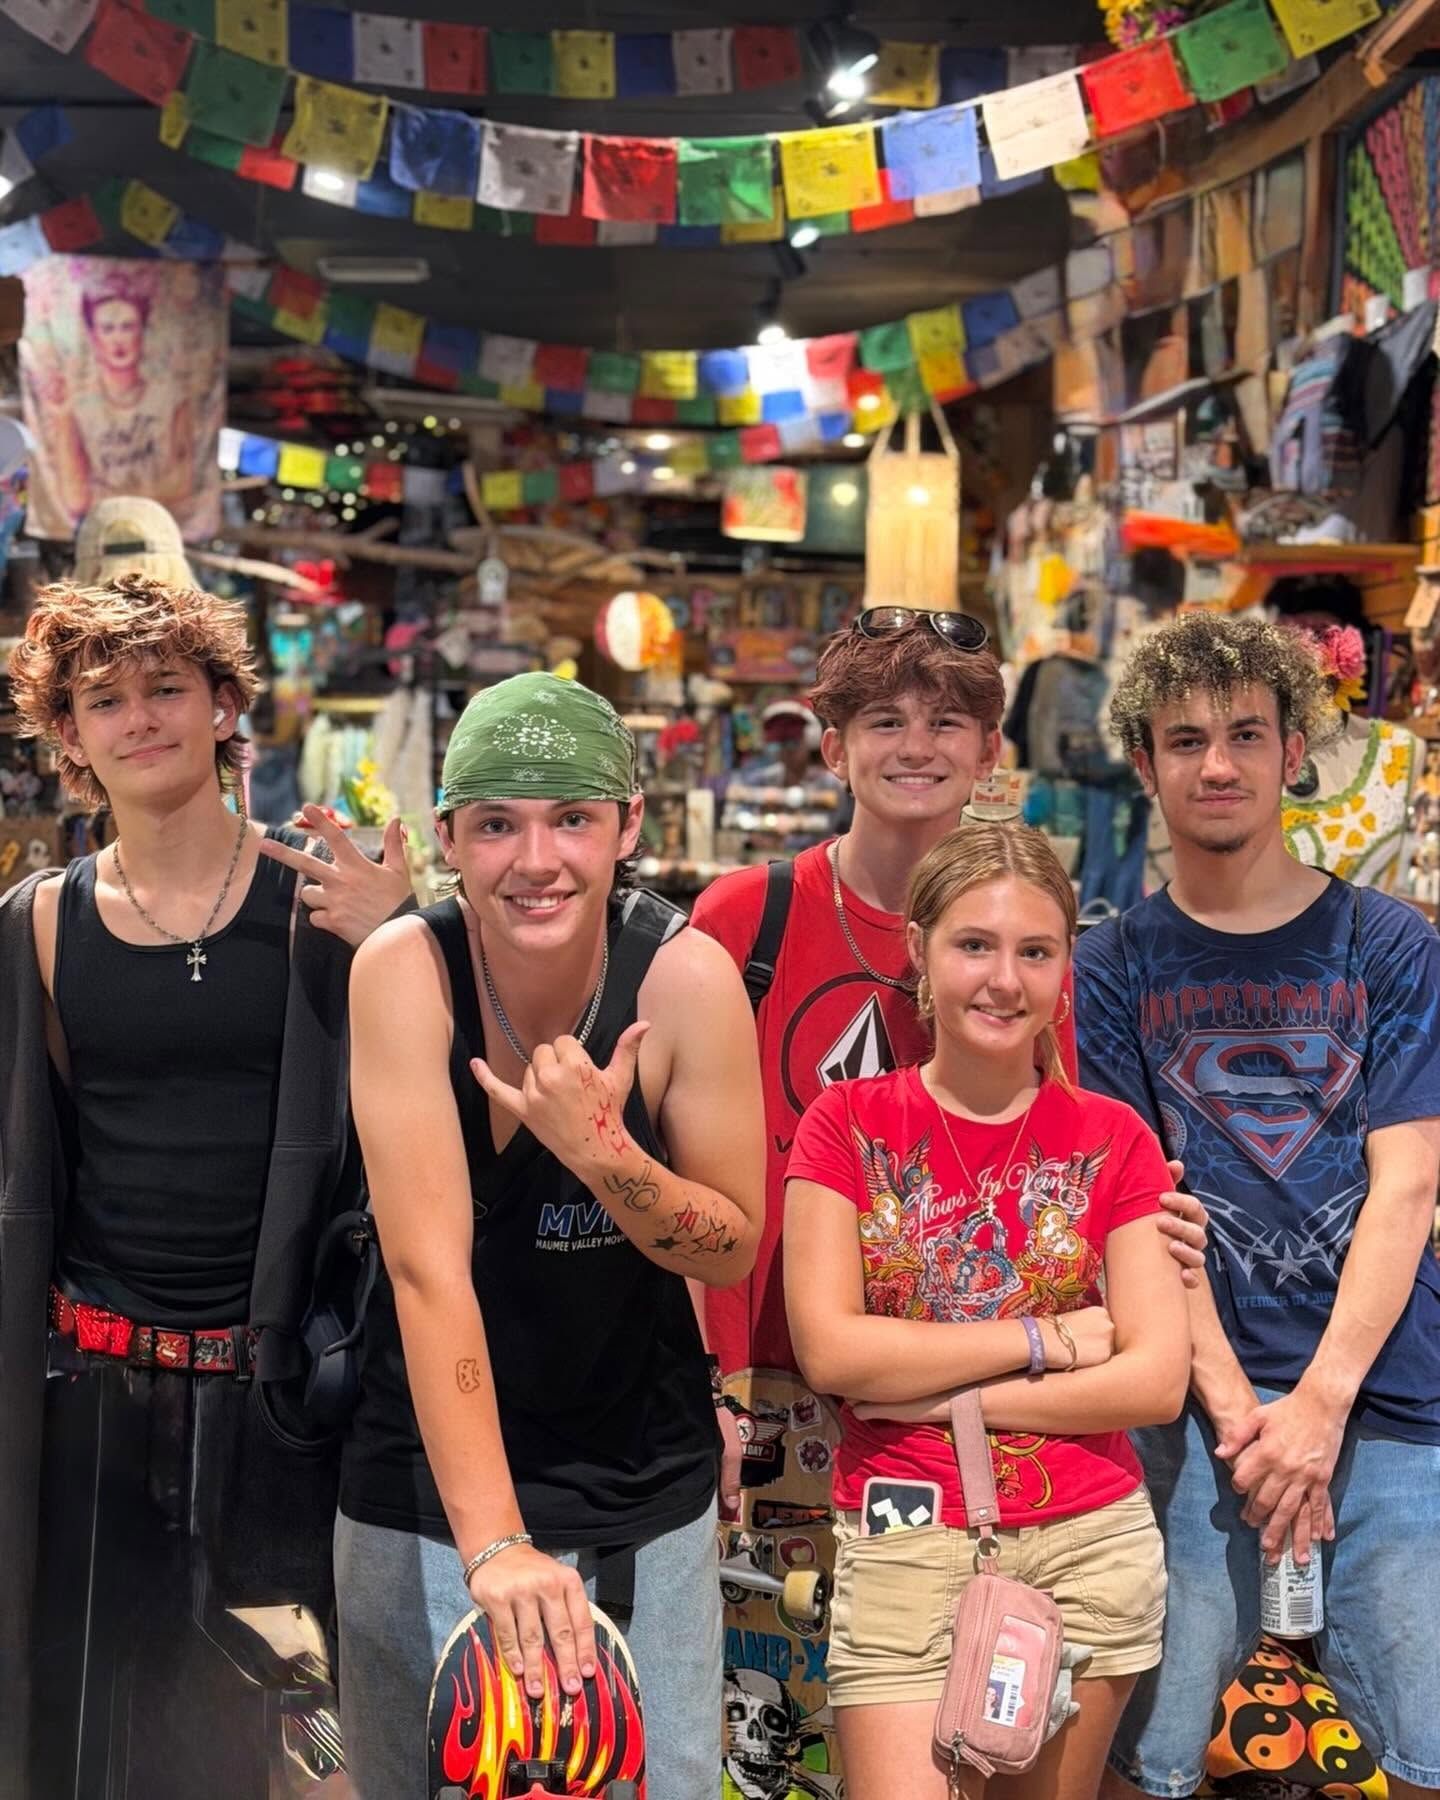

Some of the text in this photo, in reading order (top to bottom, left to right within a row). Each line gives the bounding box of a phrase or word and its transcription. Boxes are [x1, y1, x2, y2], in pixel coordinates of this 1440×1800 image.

[535, 1238, 569, 1252] MAUMEE
[571, 1236, 602, 1251] VALLEY
[748, 1444, 764, 1457] DAY
